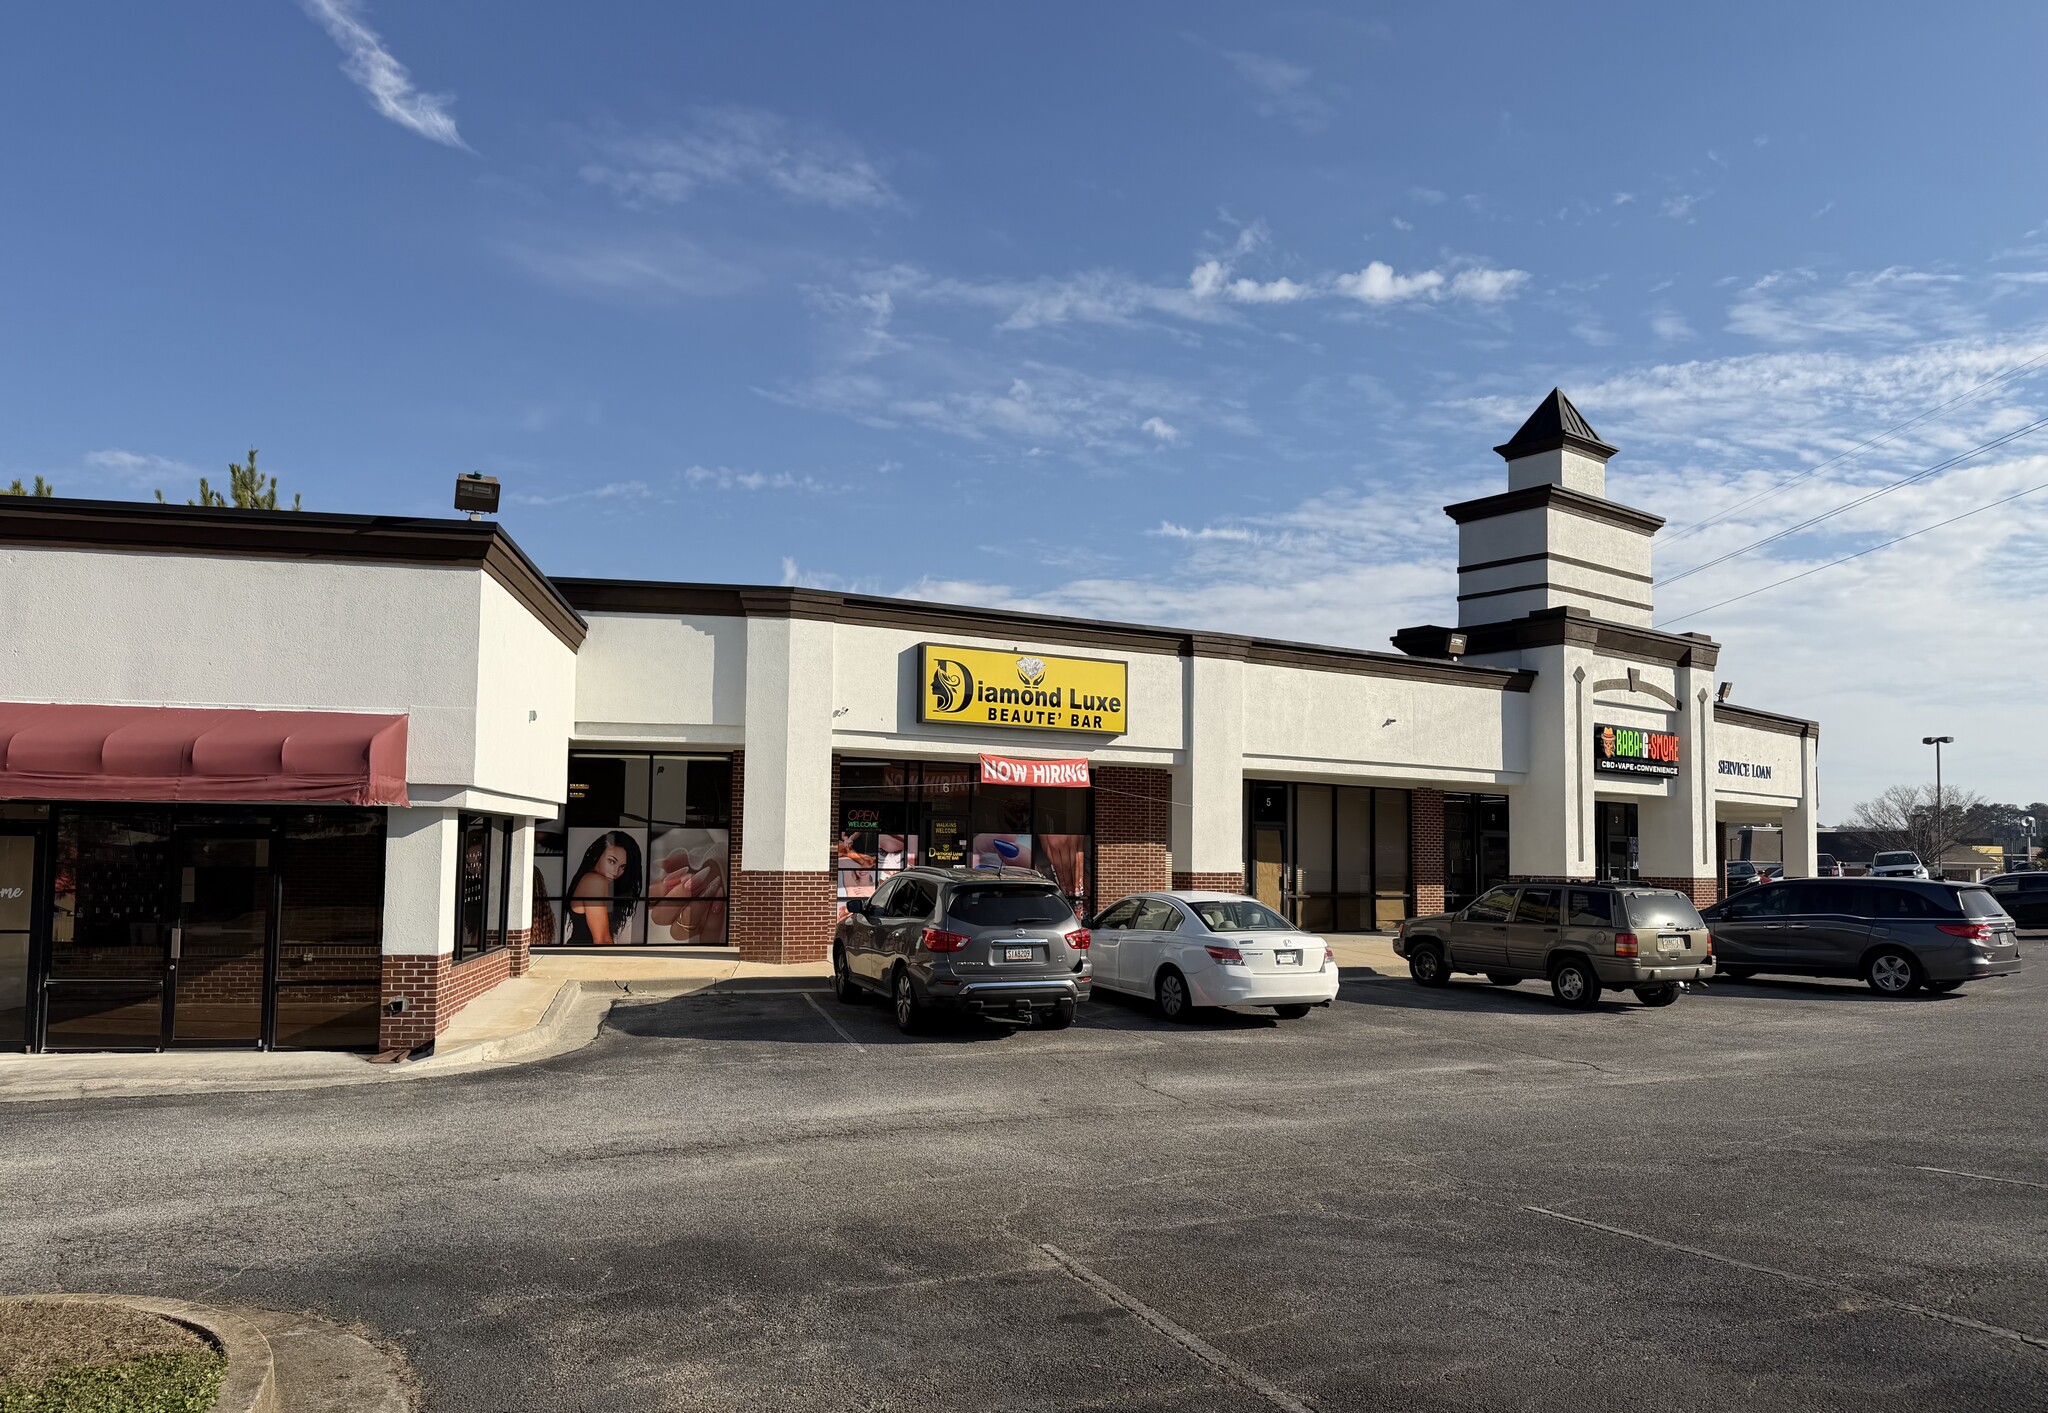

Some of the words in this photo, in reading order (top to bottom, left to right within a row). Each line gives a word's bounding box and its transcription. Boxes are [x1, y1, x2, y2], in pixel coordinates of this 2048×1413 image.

[931, 658, 1062, 713] Diamond
[1069, 688, 1122, 713] Luxe
[1070, 713, 1103, 729] BAR
[984, 760, 1027, 783] NOW
[1032, 763, 1087, 784] HIRING
[1601, 760, 1615, 769] CBD
[1617, 762, 1635, 770] VAPE
[1636, 764, 1678, 775] CONVENIENCE
[1718, 760, 1750, 777] SERVICE
[1751, 764, 1772, 779] LOAN
[942, 782, 950, 793] 6
[1266, 797, 1271, 806] 5
[847, 809, 879, 821] OPEN
[1614, 816, 1619, 824] 3
